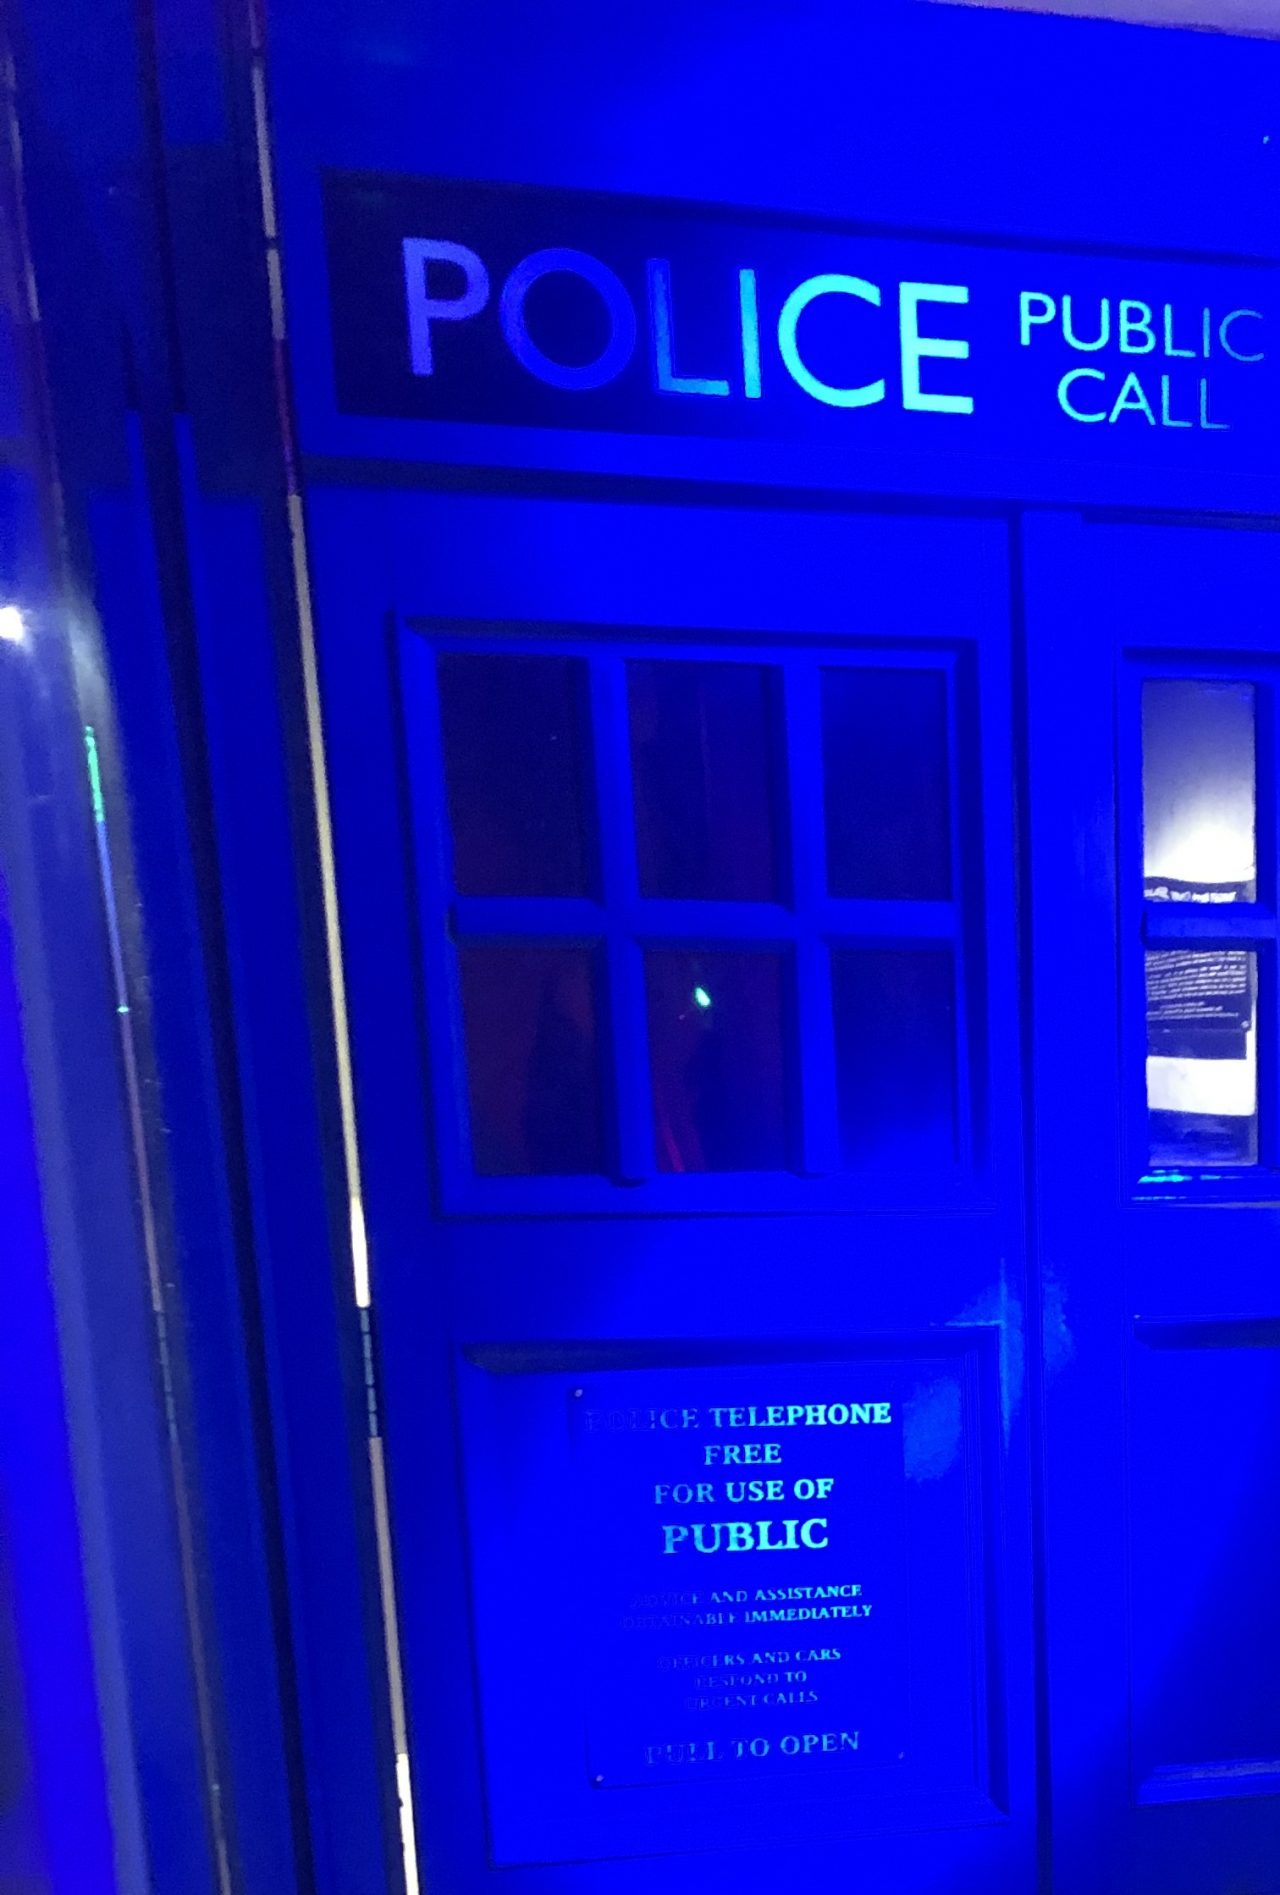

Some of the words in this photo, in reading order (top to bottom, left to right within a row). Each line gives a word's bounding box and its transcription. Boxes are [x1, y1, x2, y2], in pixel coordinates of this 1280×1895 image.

[402, 237, 974, 414] POLICE
[1019, 291, 1265, 362] PUBLIC
[1057, 367, 1231, 430] CALL
[708, 1402, 893, 1428] TELEPHONE
[704, 1442, 782, 1466] FREE
[654, 1483, 716, 1505] FOR
[725, 1479, 785, 1503] USE
[793, 1477, 835, 1501] OF
[661, 1517, 829, 1554] PUBLIC
[710, 1590, 748, 1604] AND
[754, 1584, 863, 1601] ASSISTANCE
[744, 1604, 873, 1624] IMMEDIATELY
[751, 1651, 790, 1665] AND
[795, 1648, 842, 1662] CARS
[784, 1670, 808, 1683] TO
[763, 1690, 820, 1706] CALLS
[731, 1737, 770, 1758] TO
[779, 1731, 861, 1756] OPEN
